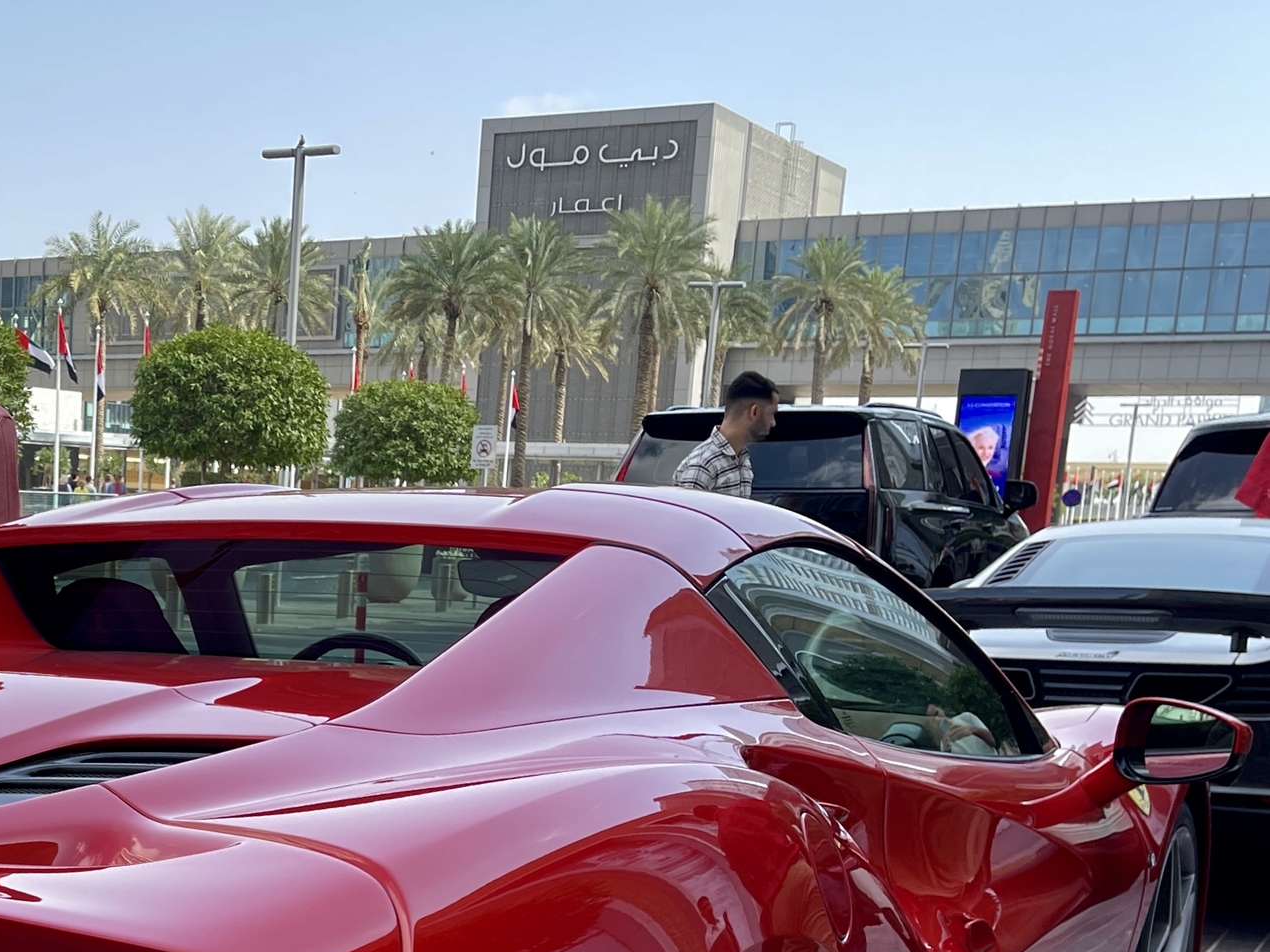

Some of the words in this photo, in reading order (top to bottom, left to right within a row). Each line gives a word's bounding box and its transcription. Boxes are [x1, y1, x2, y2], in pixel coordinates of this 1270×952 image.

[506, 143, 590, 172] مول
[598, 139, 679, 168] دبي
[1109, 413, 1172, 427] GRAND
